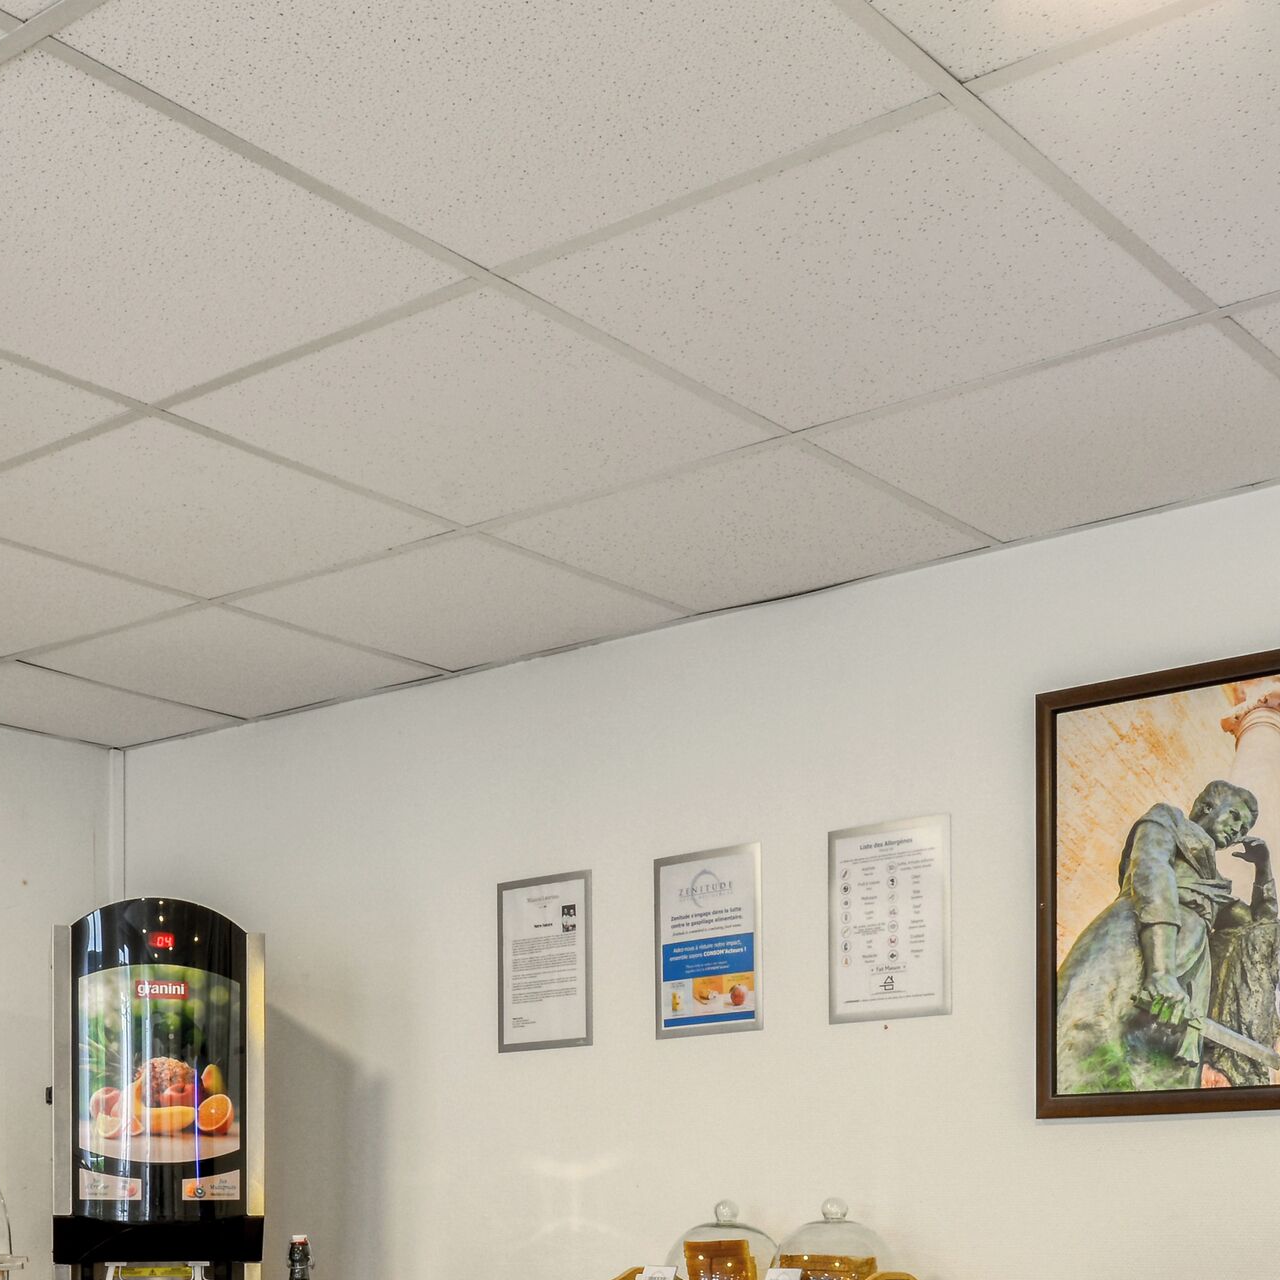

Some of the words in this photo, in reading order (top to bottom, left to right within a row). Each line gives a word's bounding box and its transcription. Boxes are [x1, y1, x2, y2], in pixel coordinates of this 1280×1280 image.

[678, 881, 733, 897] ZENITUDE
[156, 935, 173, 948] 04
[137, 983, 185, 997] granini
